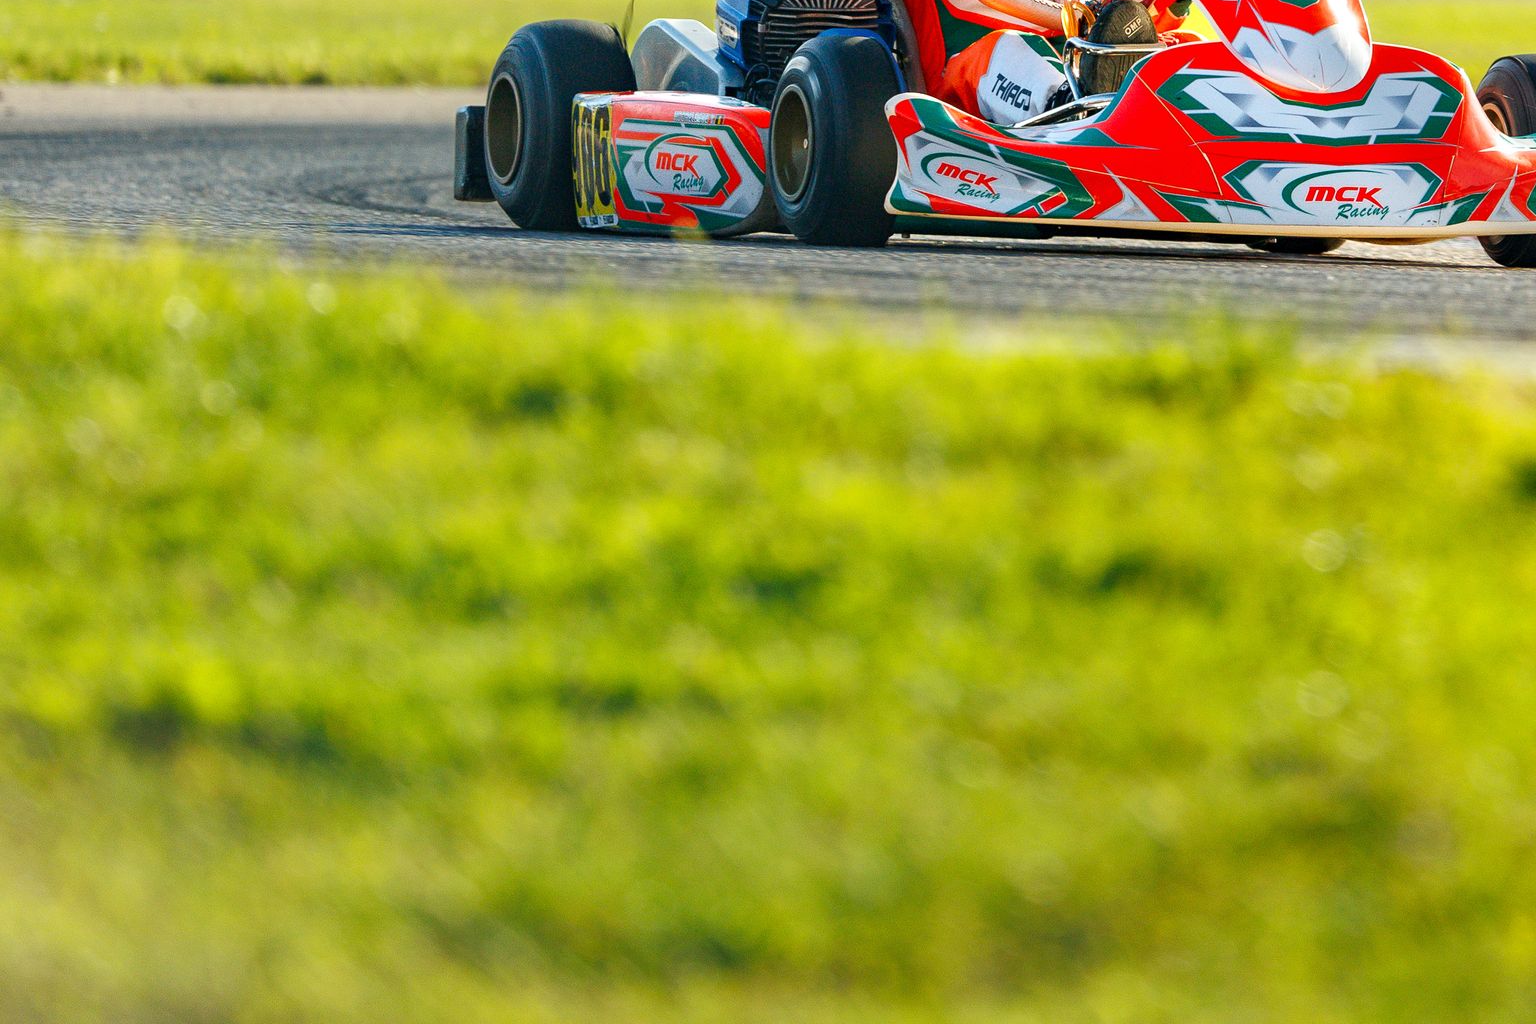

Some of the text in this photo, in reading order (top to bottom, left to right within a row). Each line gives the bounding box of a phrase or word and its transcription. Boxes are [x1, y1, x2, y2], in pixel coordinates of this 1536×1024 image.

[1124, 18, 1142, 35] OMP
[991, 73, 1032, 111] THIAGO
[655, 152, 699, 179] MCK
[673, 173, 704, 192] Racing
[936, 162, 998, 194] MCK
[955, 183, 1000, 203] Racing
[1305, 187, 1384, 209] MCK
[1335, 203, 1389, 220] Racing
